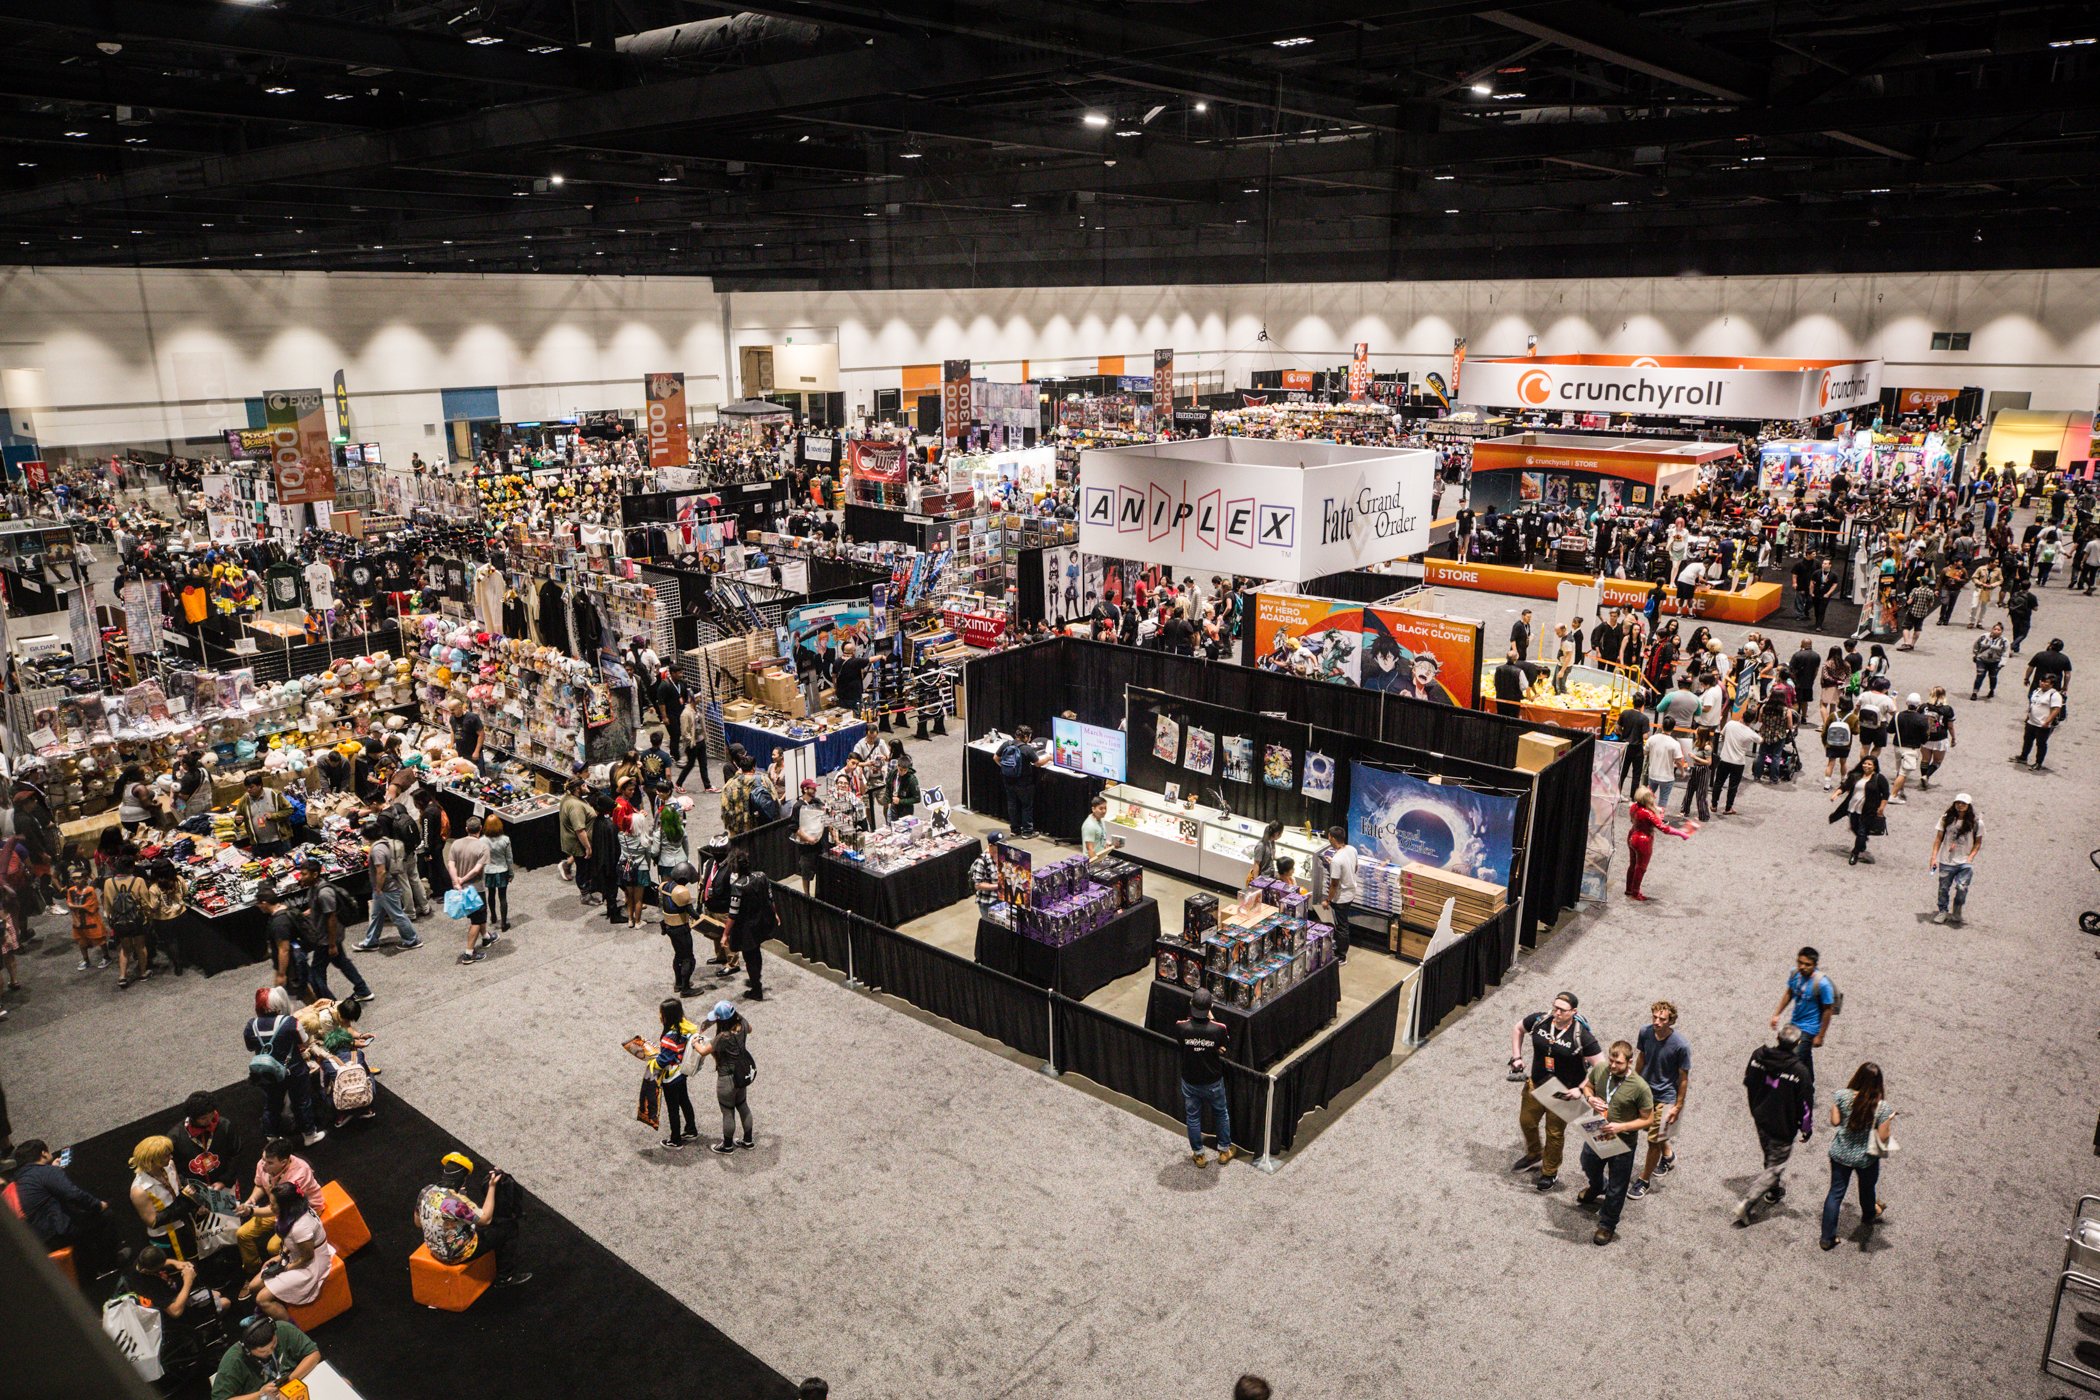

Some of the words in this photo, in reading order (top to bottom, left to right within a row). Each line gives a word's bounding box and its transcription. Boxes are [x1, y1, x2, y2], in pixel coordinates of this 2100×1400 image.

[1352, 361, 1360, 395] 1400
[1359, 360, 1367, 396] 1500
[1452, 354, 1460, 386] 1600
[289, 394, 320, 409] EXPO
[1154, 370, 1163, 409] 1300
[1163, 369, 1172, 409] 1400
[1560, 377, 1723, 409] crunchyroll
[1830, 372, 1870, 403] crunchyroll
[946, 385, 958, 431] 1200
[959, 383, 971, 430] 1300
[650, 403, 668, 458] 1100
[1535, 457, 1570, 467] crunchyroll
[1575, 460, 1598, 468] STORE
[1872, 444, 1895, 452] CARD
[274, 427, 306, 502] 1000
[1356, 481, 1401, 516] Grand
[1091, 493, 1291, 540] ANIPLEX
[1321, 498, 1354, 545] Fate
[1375, 507, 1417, 539] Order
[1439, 567, 1478, 584] STORE
[1260, 604, 1274, 612] MY
[1275, 606, 1300, 616] HERO
[1260, 613, 1309, 626] ACADEMIA
[29, 643, 56, 652] GILDAN
[1396, 623, 1429, 636] BLACK
[1430, 629, 1471, 643] CLOVER
[1361, 816, 1384, 840] Fate
[1386, 823, 1421, 840] Grand
